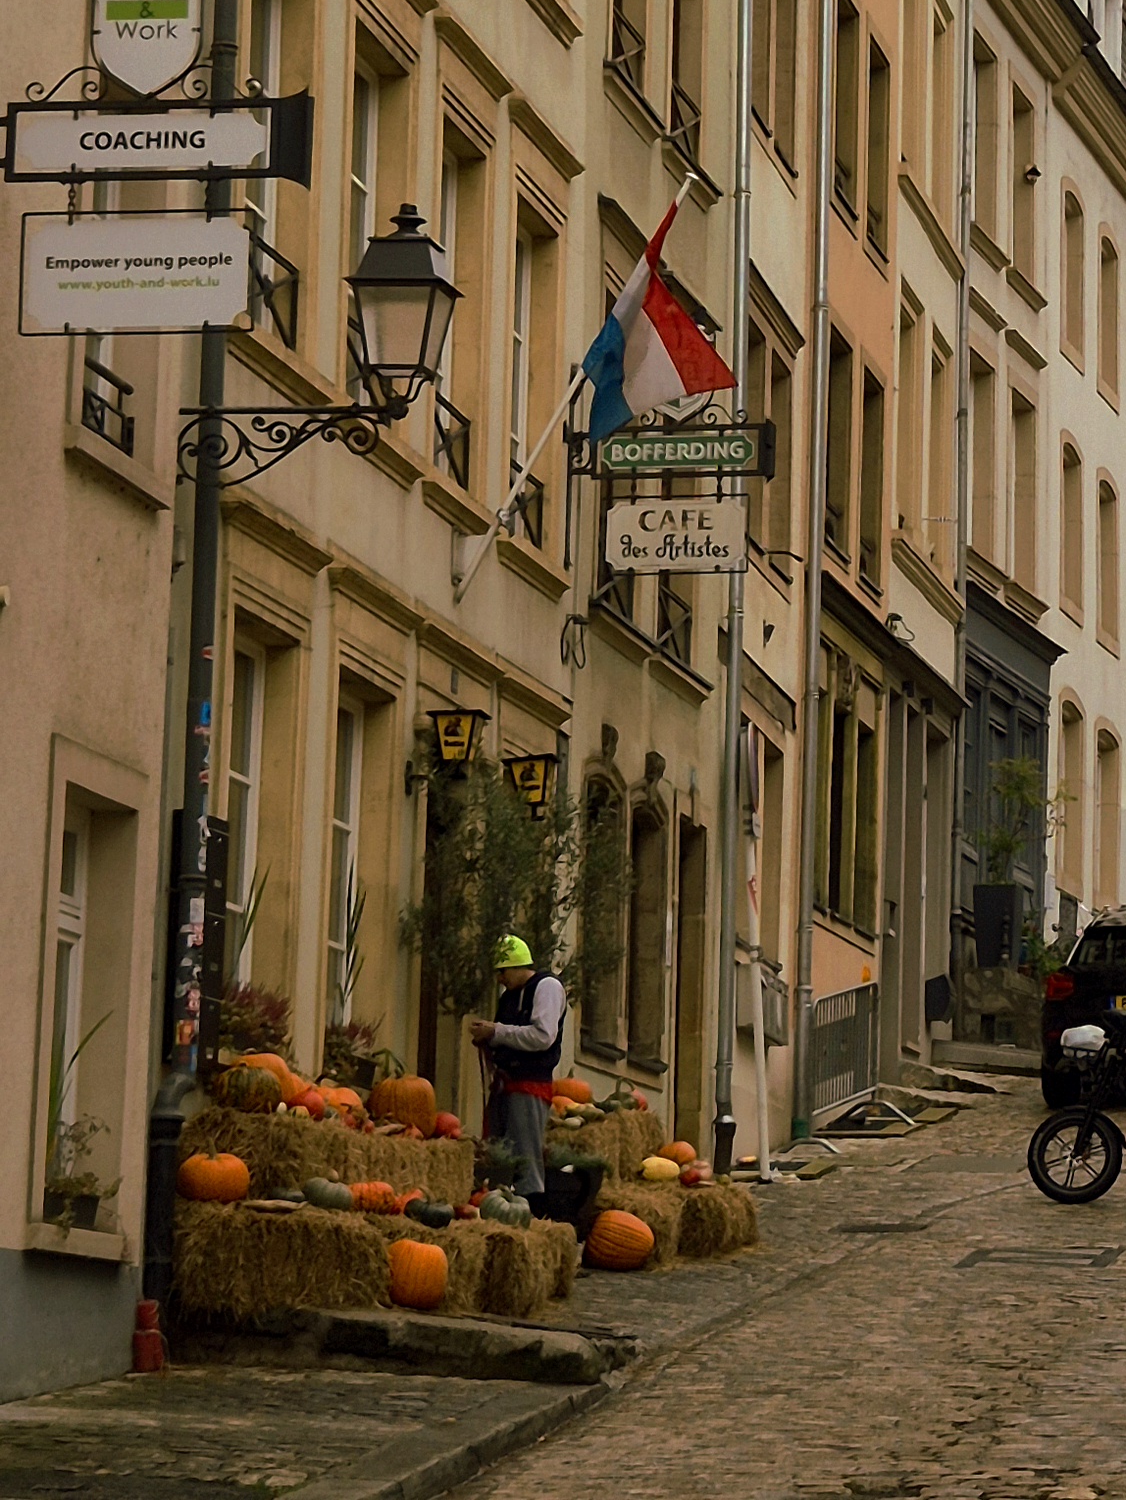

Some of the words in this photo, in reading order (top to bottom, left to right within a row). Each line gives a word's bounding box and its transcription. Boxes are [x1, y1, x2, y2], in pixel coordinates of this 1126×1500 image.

[139, 1, 154, 18] &
[115, 19, 179, 41] Work
[79, 130, 206, 151] COACHING
[45, 255, 120, 271] Empower
[124, 254, 174, 270] young
[177, 252, 233, 269] people
[57, 275, 220, 292] www.youth-and-work.lu
[611, 441, 745, 462] BOFFERDING
[638, 509, 714, 532] CAFE
[620, 534, 648, 559] des
[655, 533, 730, 561] Artistes
